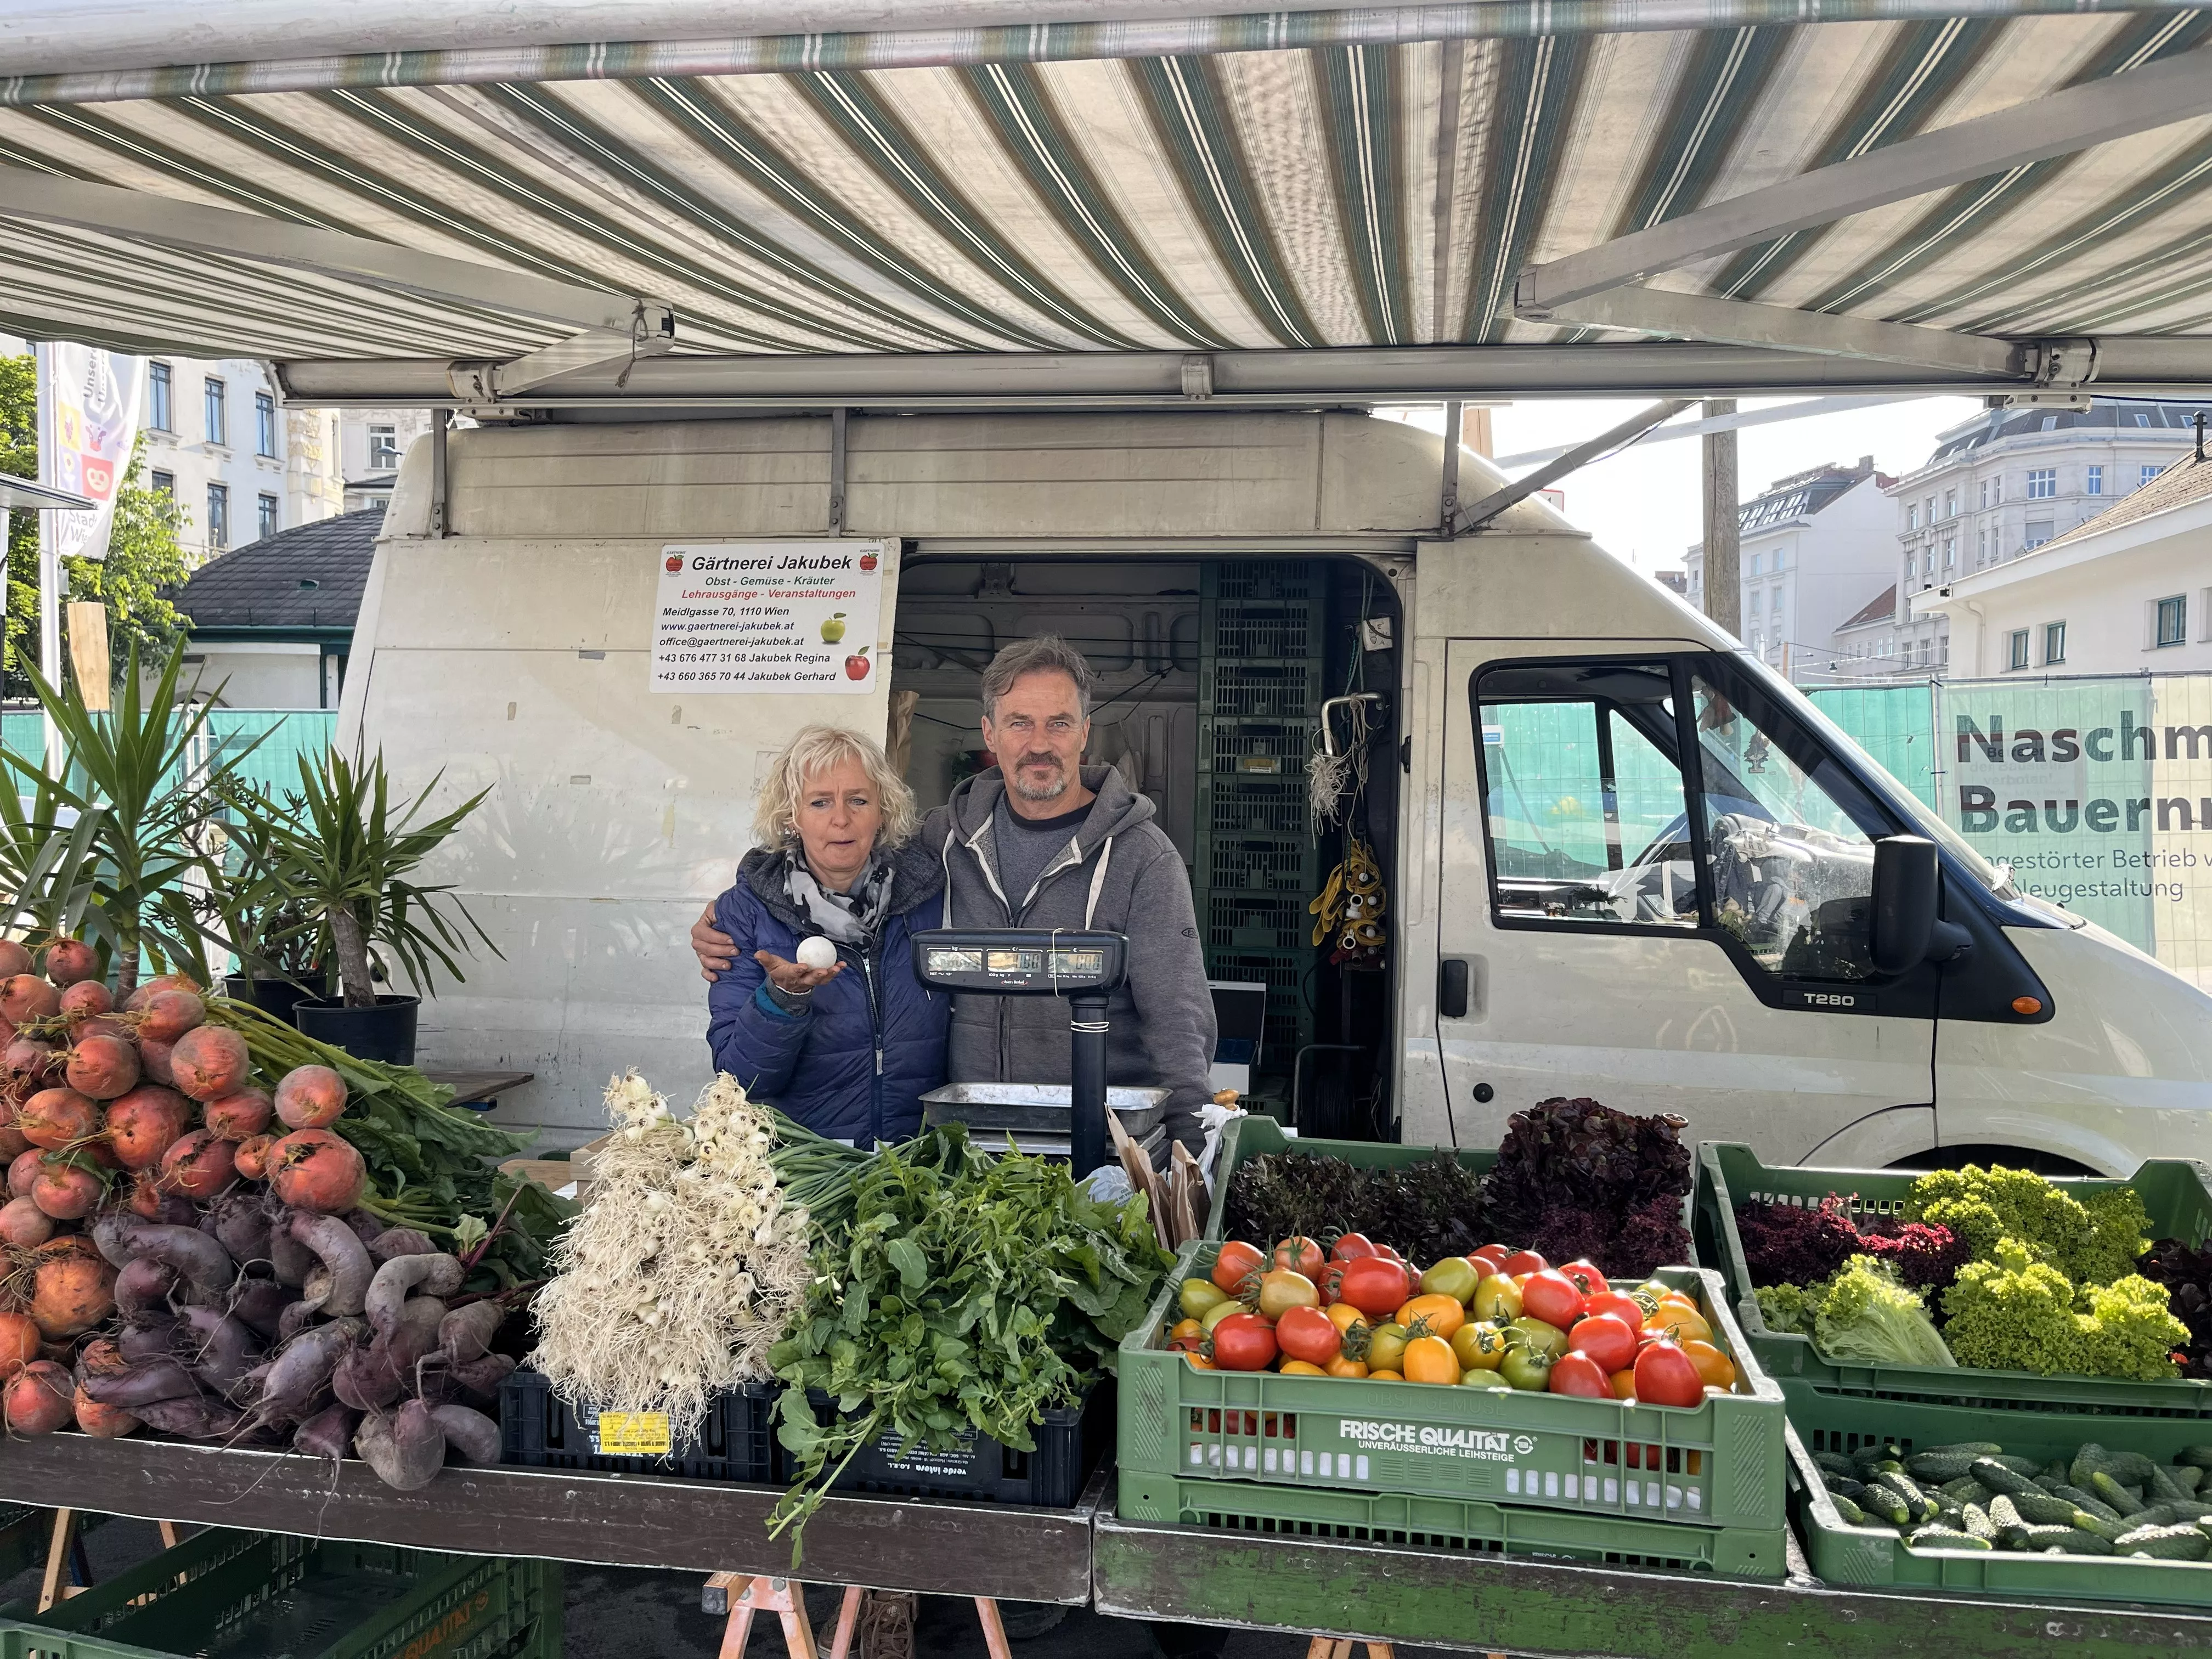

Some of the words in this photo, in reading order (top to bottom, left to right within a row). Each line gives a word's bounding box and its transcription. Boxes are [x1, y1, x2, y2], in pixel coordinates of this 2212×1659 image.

[71, 525, 88, 543] Wi
[692, 556, 774, 571] Gärtnerei
[777, 555, 853, 569] Jakubek
[706, 577, 731, 585] Obst
[741, 576, 784, 585] Gemüse
[794, 576, 836, 585] Kräuter
[681, 589, 758, 600] Lehrausgänge
[768, 589, 856, 600] Veranstaltungen
[662, 607, 719, 618] Meidlgasse
[723, 607, 736, 617] 70,
[740, 607, 761, 616] 1110
[764, 607, 789, 616] Wien
[661, 622, 794, 632] www.gaertnerei-jakubek.at
[659, 637, 804, 648] office@gaertnerei-jakubek.at
[658, 653, 676, 662] +43
[679, 653, 697, 662] 676
[699, 653, 717, 662] 477
[720, 653, 731, 662] 31
[735, 653, 747, 662] 68
[749, 653, 792, 662] Jakubek
[795, 653, 831, 664] Regina
[658, 672, 676, 680] +43
[678, 672, 696, 680] 660
[698, 672, 716, 680] 365
[719, 672, 731, 680] 70
[733, 672, 746, 680] 44
[748, 672, 791, 680] Jakubek
[794, 672, 837, 680] Gerhard
[1956, 710, 2212, 763] Naschm
[1970, 762, 1993, 773] der
[1984, 774, 2053, 785] verboten!
[1984, 851, 2105, 869] ngestörter
[2113, 848, 2197, 868] Betrieb
[1803, 992, 1854, 1007] T280
[1340, 1420, 1416, 1443] FRISCHE
[1419, 1426, 1510, 1452] QUALITÄT
[1358, 1440, 1457, 1457] UNVERÄUSSERLICHE
[1458, 1448, 1515, 1463] LEIHSTEIGE
[943, 1466, 967, 1476] verde
